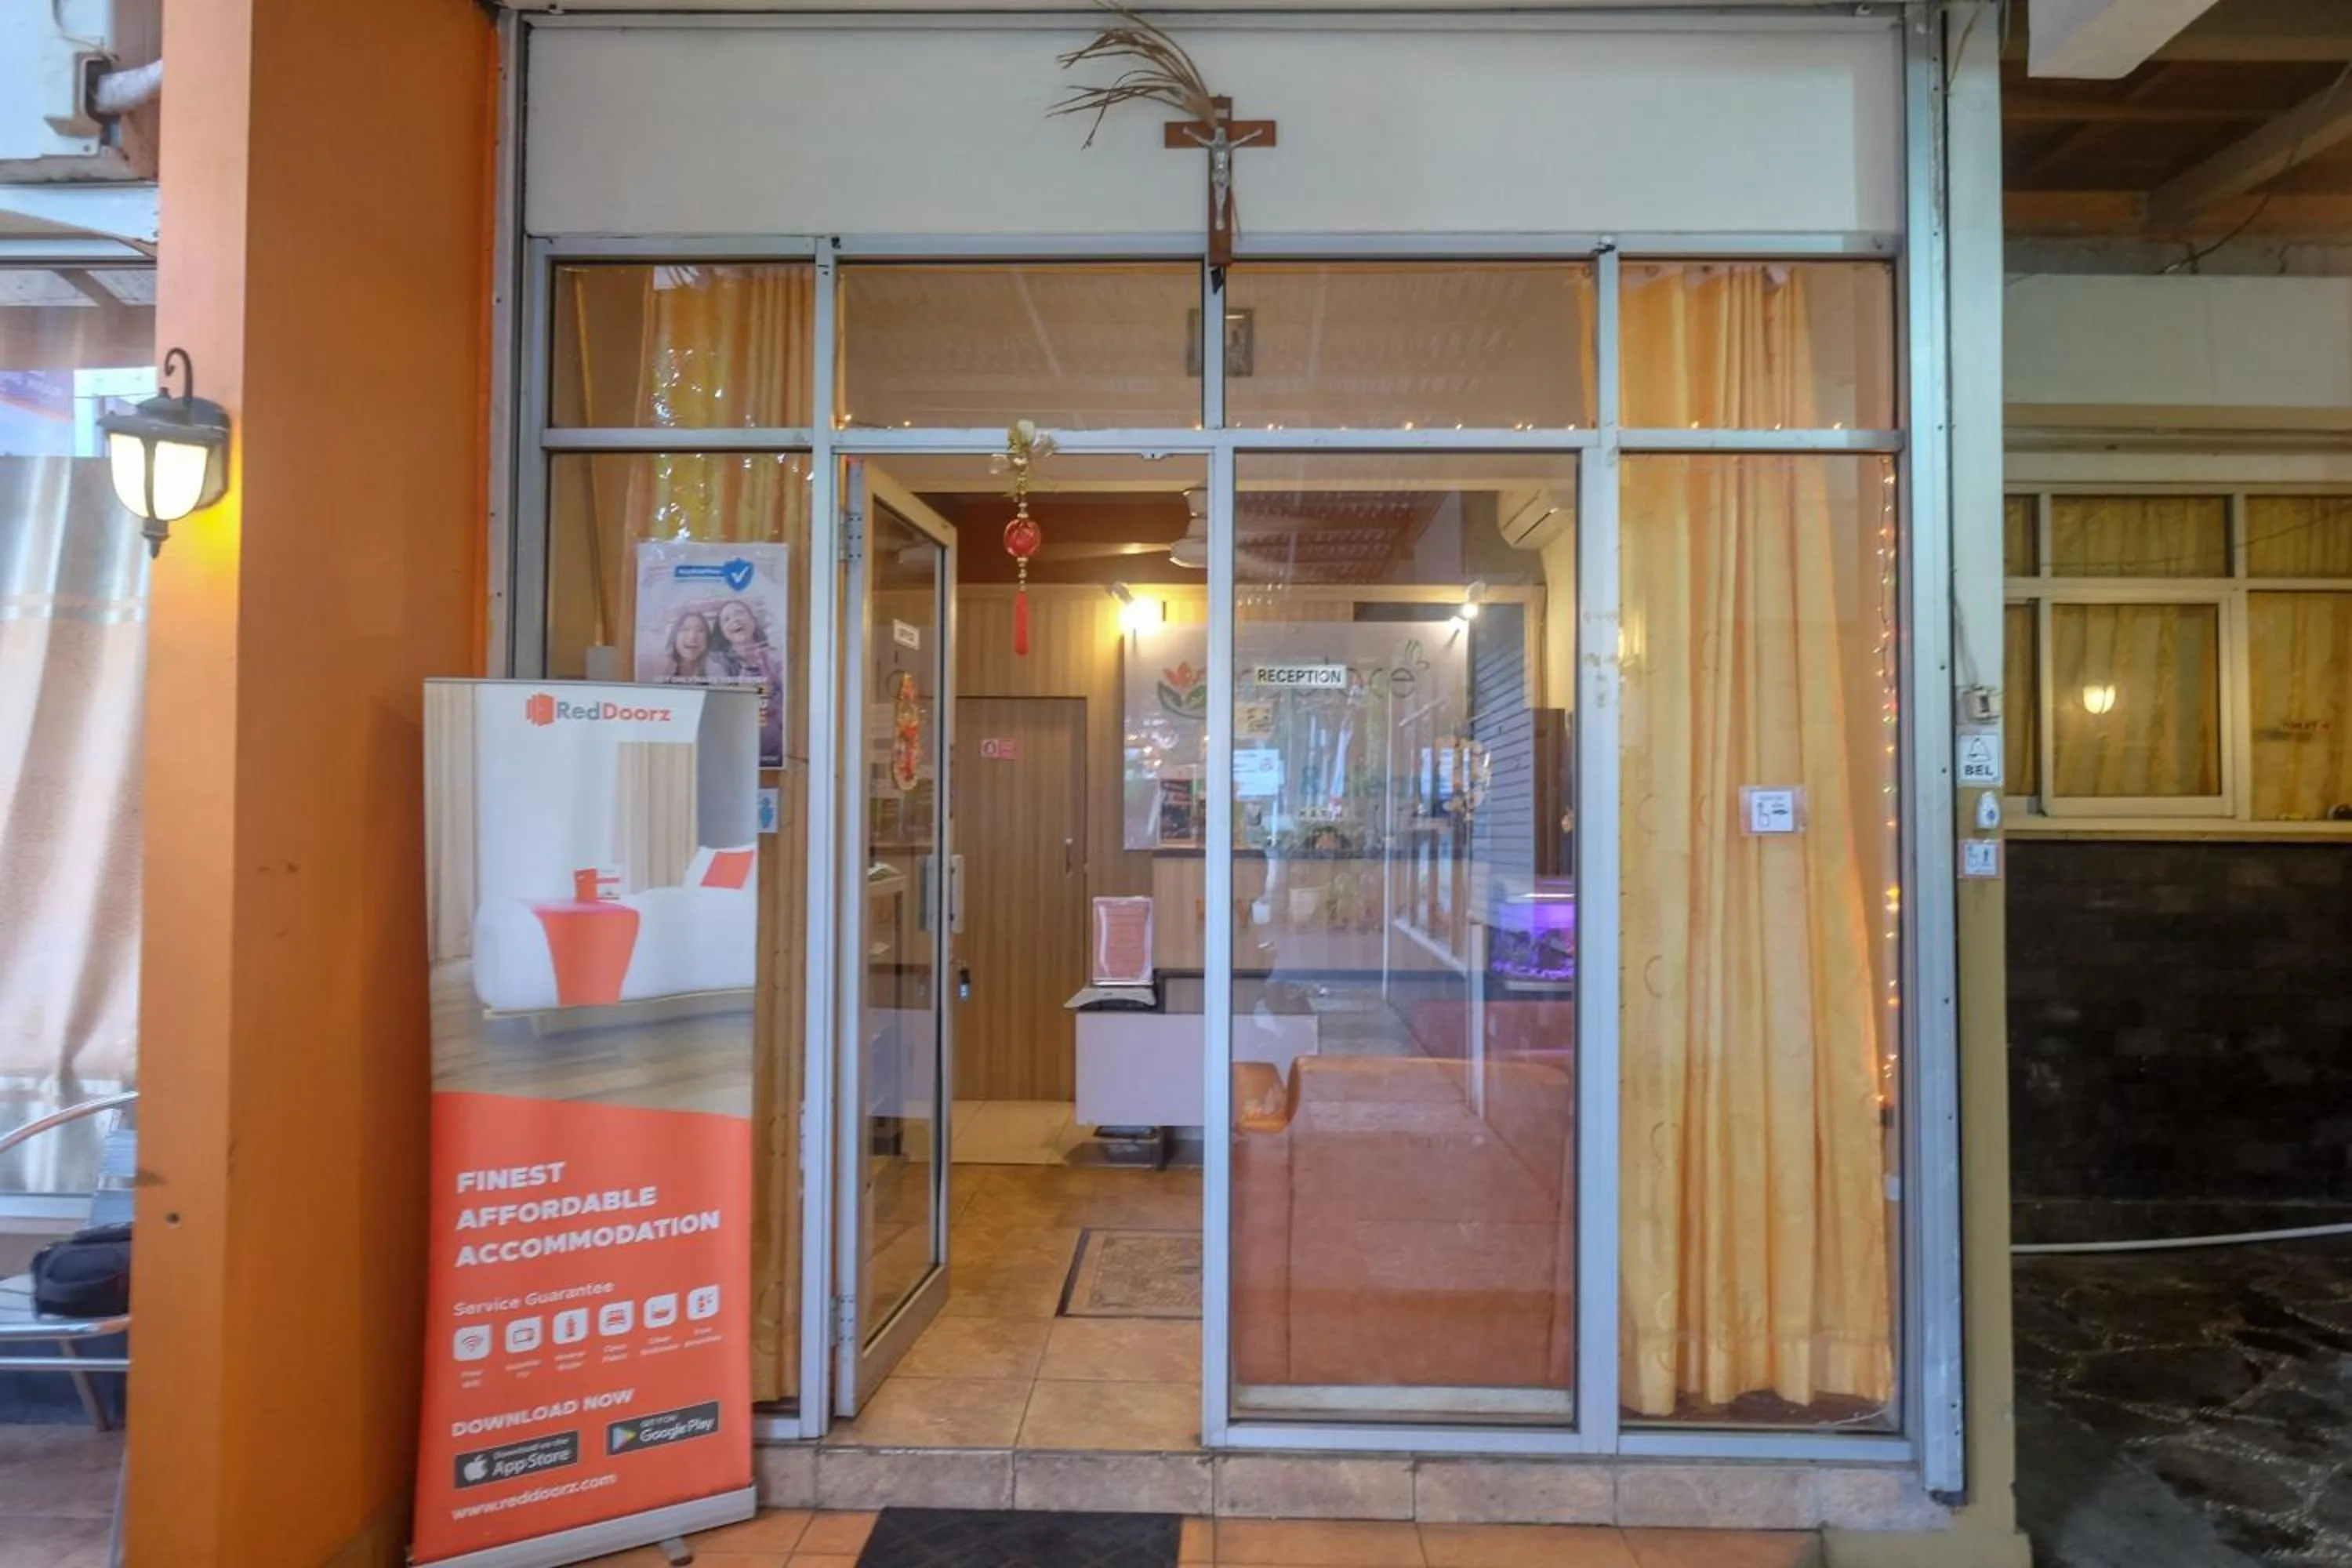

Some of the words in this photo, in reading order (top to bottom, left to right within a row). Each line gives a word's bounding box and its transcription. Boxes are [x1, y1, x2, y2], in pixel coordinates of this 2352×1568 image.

[1257, 667, 1343, 684] RECEPTION
[556, 700, 672, 724] RedDoorz
[1964, 764, 1994, 776] BEL
[456, 1160, 566, 1194] FINEST
[456, 1185, 659, 1231] AFFORDABLE
[454, 1210, 722, 1269] ACCOMMODATION
[452, 1294, 521, 1317] Service
[524, 1280, 615, 1308] Guarantee
[452, 1400, 578, 1436] DOWNLOAD
[583, 1389, 633, 1410] NOW
[639, 1423, 687, 1443] Google
[687, 1417, 714, 1433] Play
[492, 1458, 525, 1477] App
[526, 1449, 569, 1468] Store
[452, 1473, 616, 1519] www.reddoorz.com
